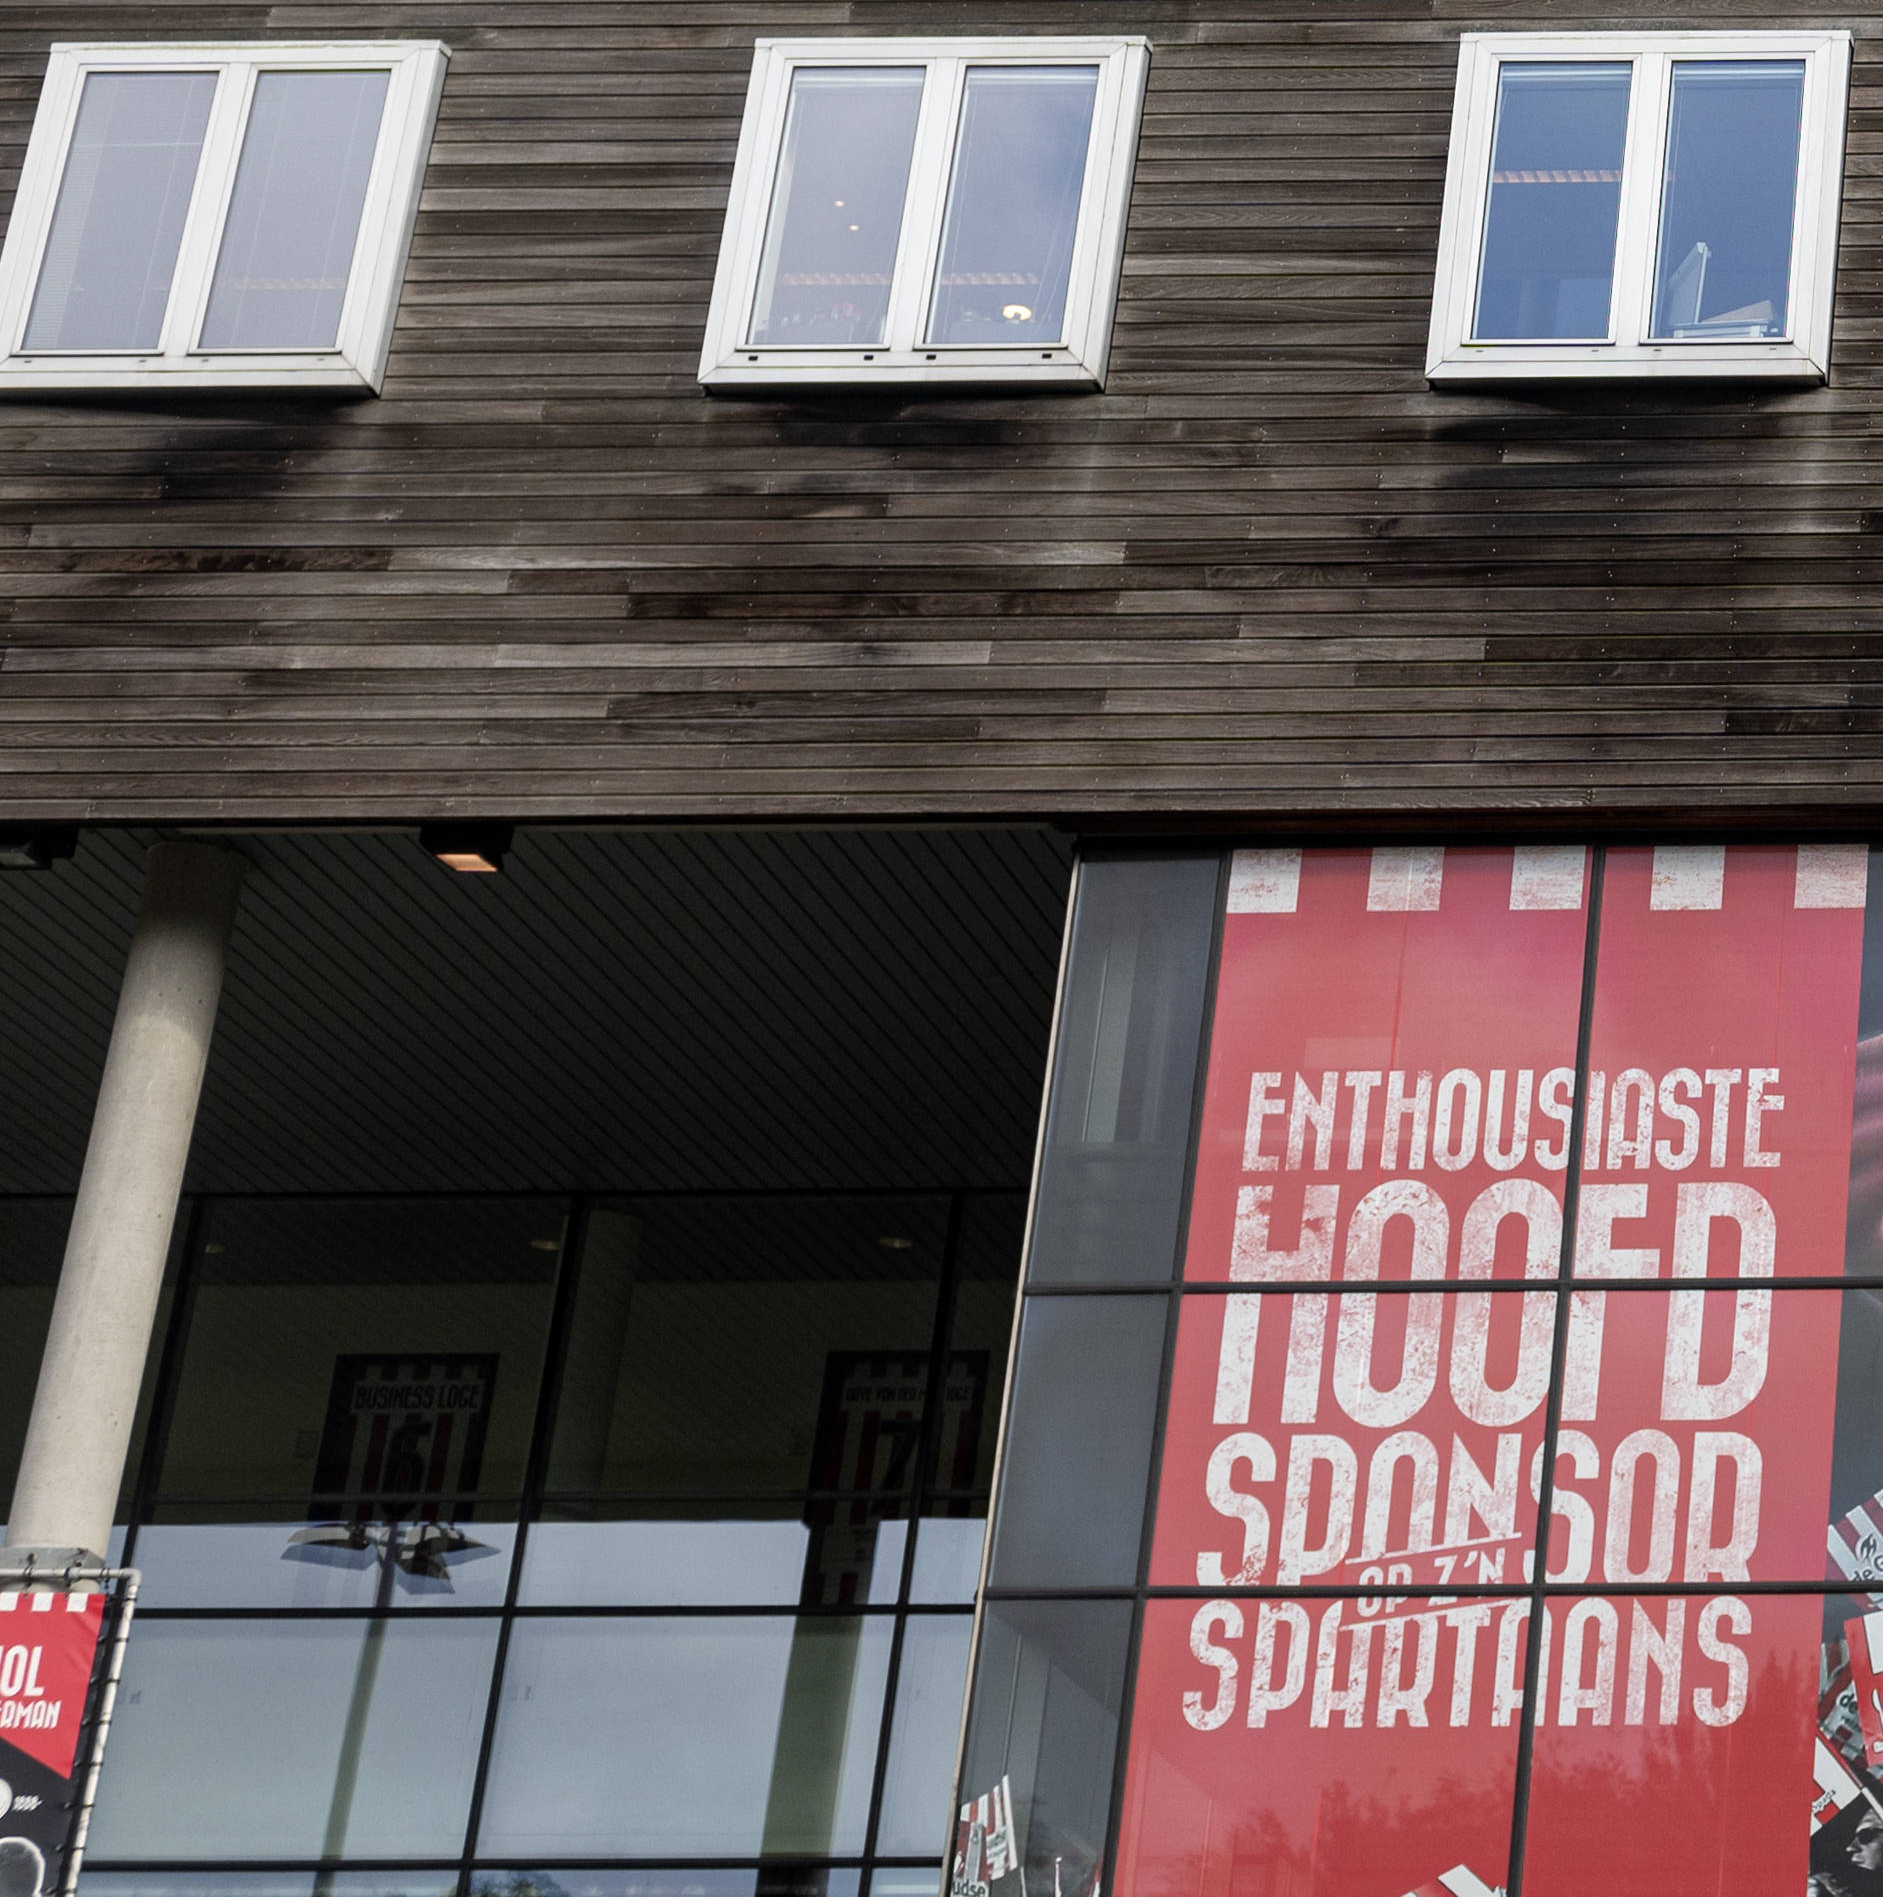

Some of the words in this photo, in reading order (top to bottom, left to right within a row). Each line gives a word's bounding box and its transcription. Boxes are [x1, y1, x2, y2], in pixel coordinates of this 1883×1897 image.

[1241, 1066, 1785, 1172] ENTHOUSIASTE
[1212, 1179, 1777, 1427] HOOFD
[355, 1384, 434, 1410] BUSINESS
[437, 1383, 481, 1409] LOGE
[1197, 1429, 1763, 1587] SPONSOR
[1357, 1563, 1412, 1617] OP
[0, 1644, 45, 1697] OL
[1183, 1594, 1752, 1730] SPARTAANS
[0, 1700, 62, 1728] AMAN
[952, 1878, 986, 1897] udse
